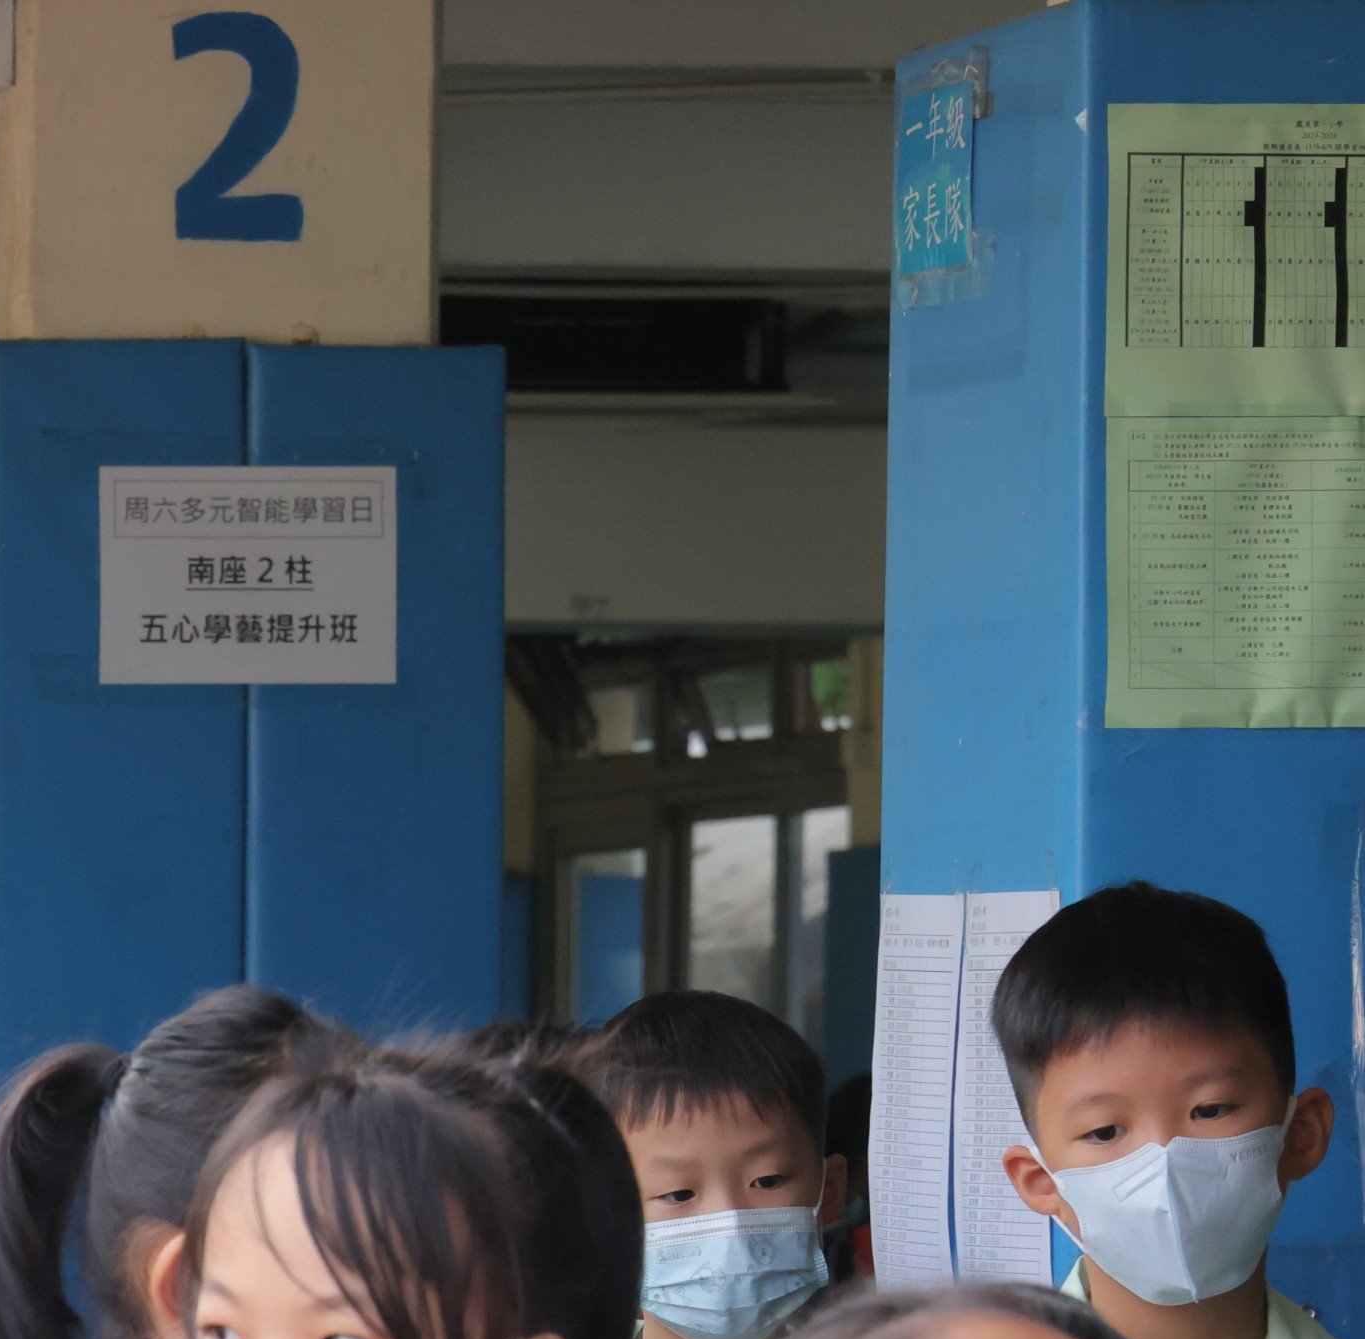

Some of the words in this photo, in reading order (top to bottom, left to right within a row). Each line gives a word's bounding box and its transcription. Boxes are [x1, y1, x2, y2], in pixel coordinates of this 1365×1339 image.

[172, 11, 304, 242] 2
[905, 93, 966, 160] 一年級
[903, 178, 965, 251] 家長隊
[124, 496, 373, 524] 周六多元智能學習日
[187, 554, 247, 586] 南座
[257, 557, 274, 585] 2
[284, 554, 314, 586] 柱
[139, 614, 358, 646] 五心學藝提升班
